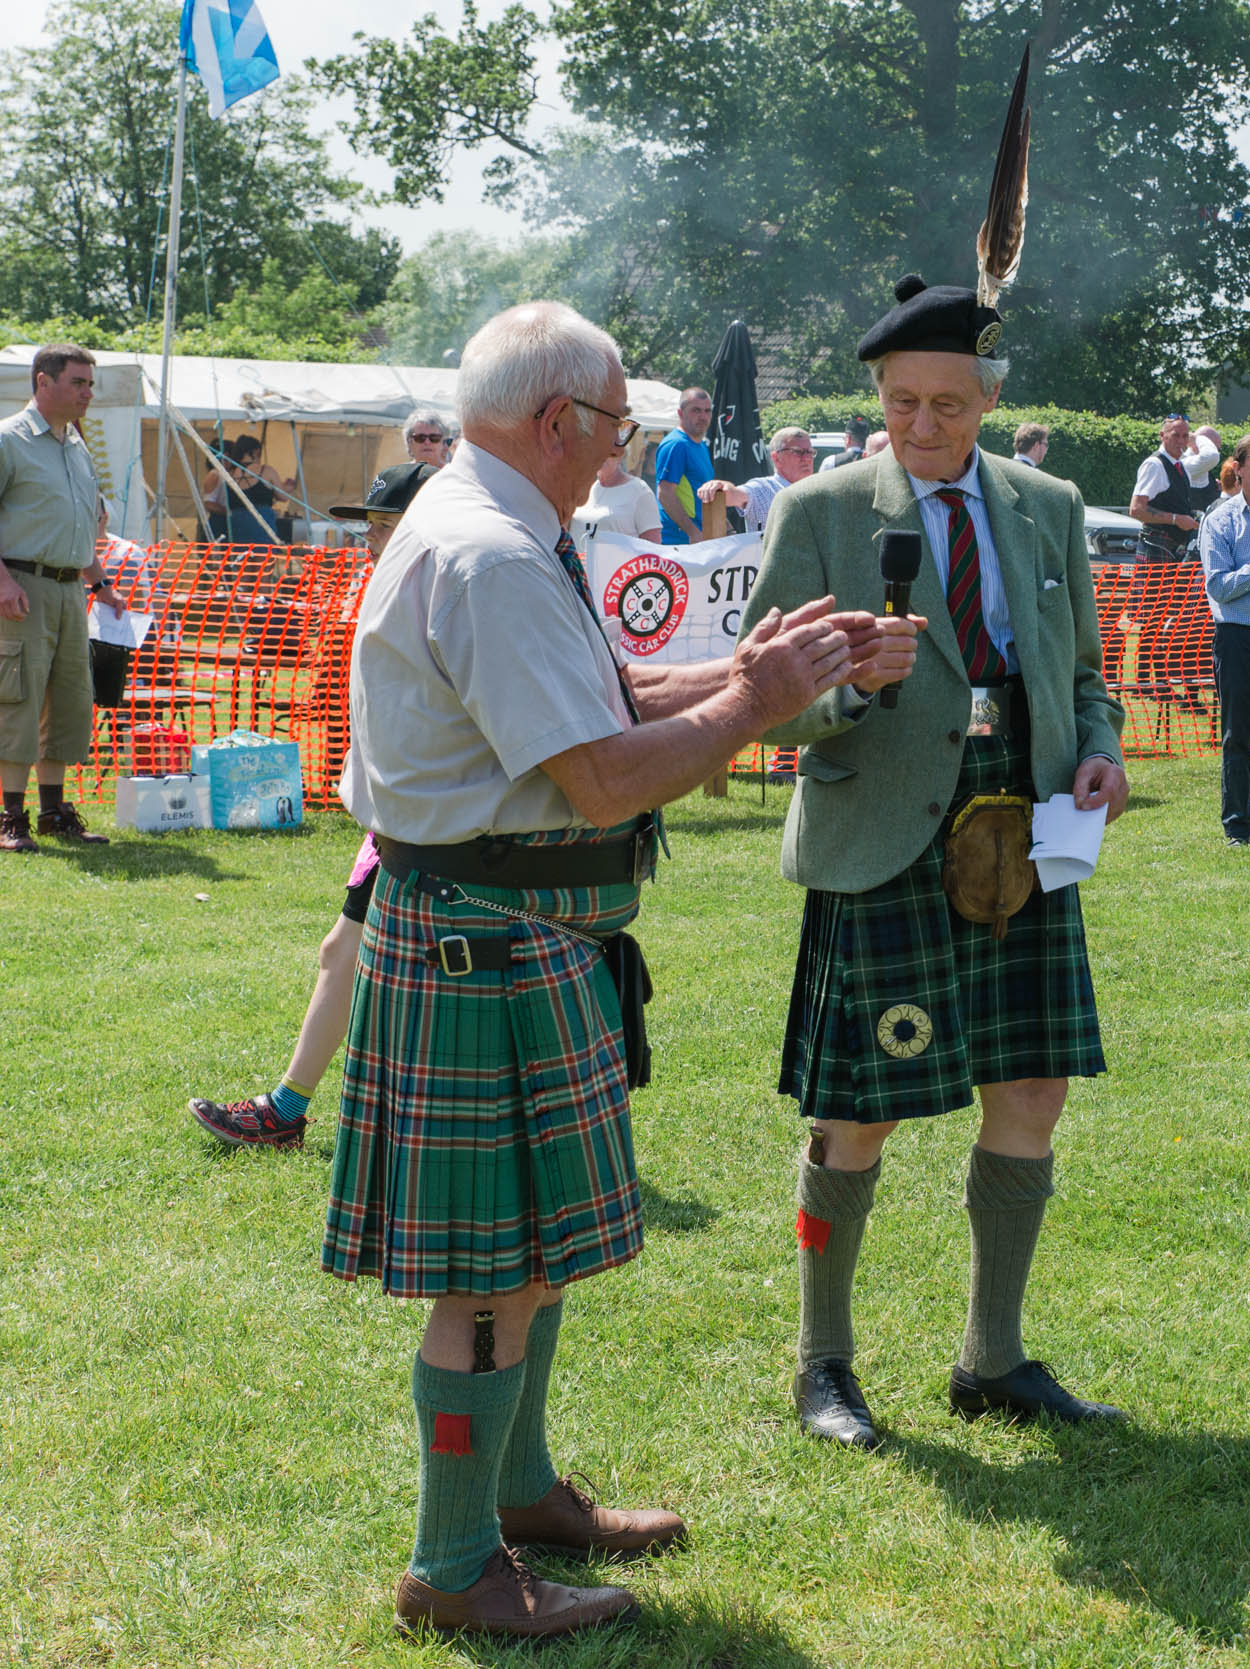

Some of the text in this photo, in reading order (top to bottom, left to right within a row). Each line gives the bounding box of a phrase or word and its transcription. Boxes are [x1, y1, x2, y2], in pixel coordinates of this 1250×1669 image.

[606, 558, 687, 604] STRATHENDRICK
[708, 566, 759, 604] STR
[639, 638, 660, 653] CAR
[659, 614, 679, 640] CLUB
[161, 811, 194, 821] ELEMIS
